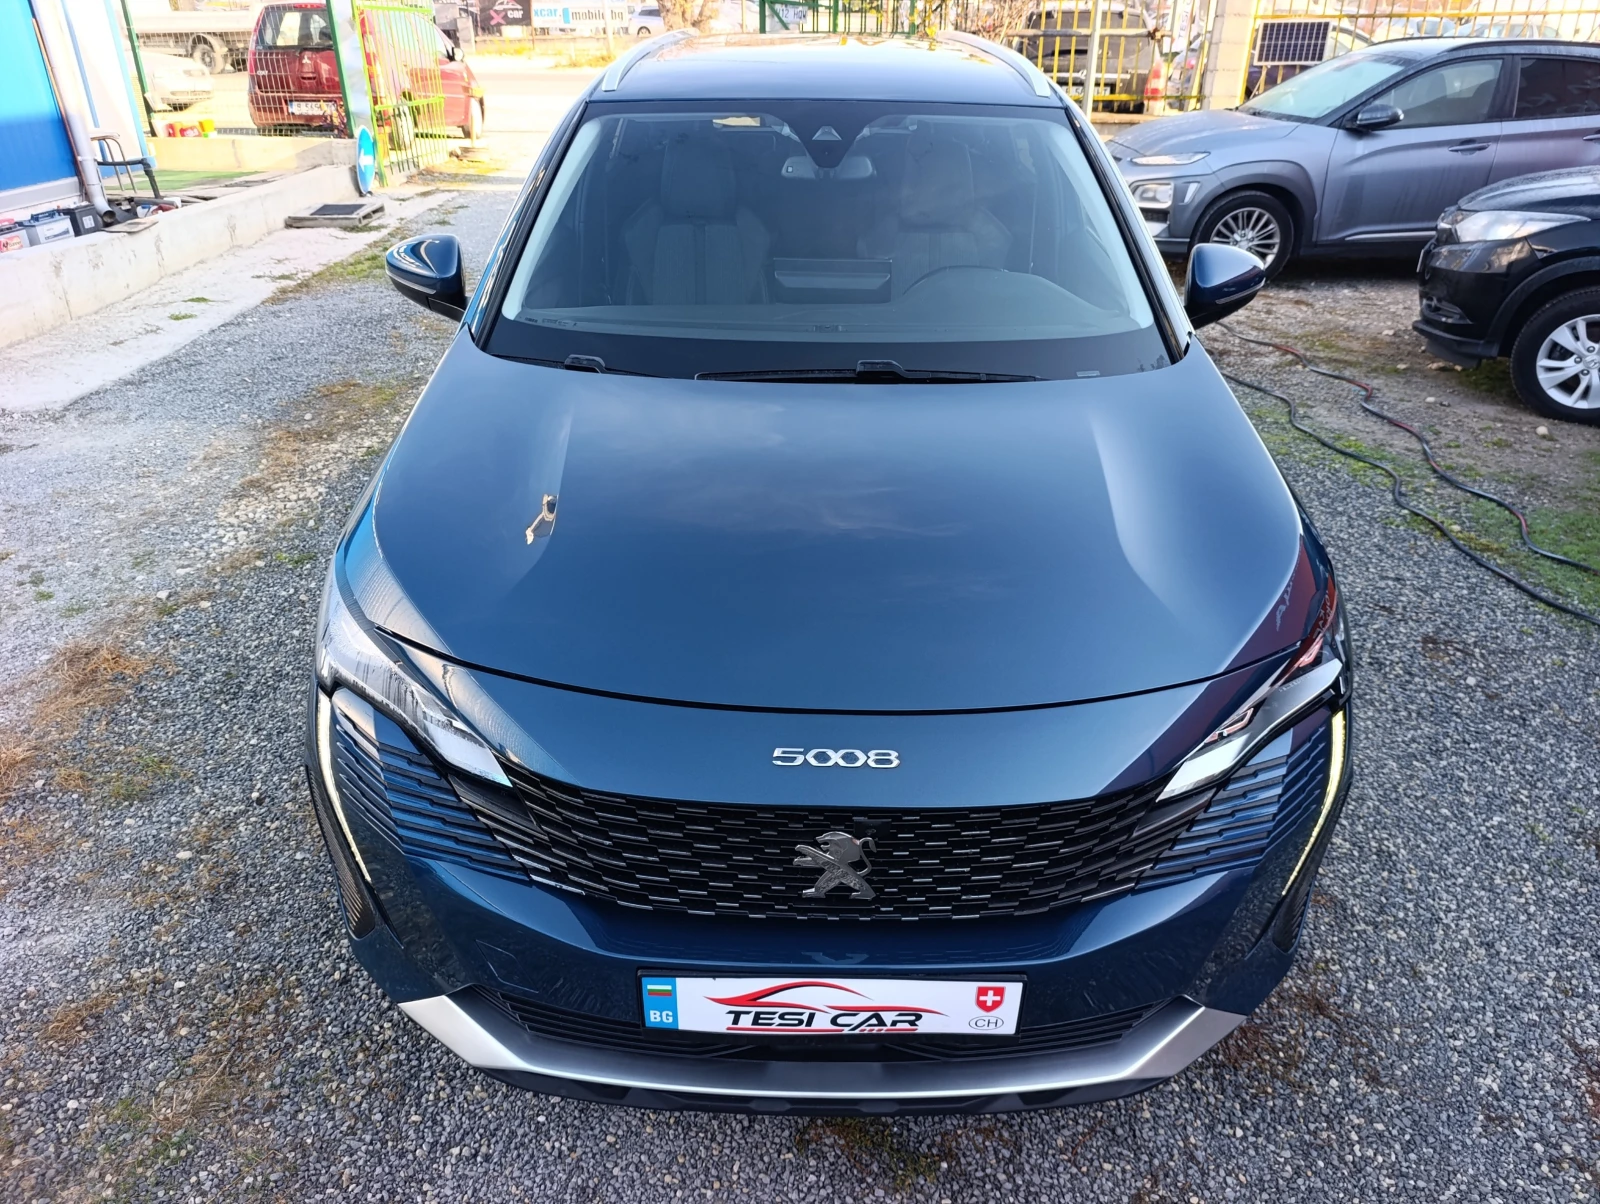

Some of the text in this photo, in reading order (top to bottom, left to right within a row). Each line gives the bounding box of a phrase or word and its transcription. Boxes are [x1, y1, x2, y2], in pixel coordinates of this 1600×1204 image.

[507, 10, 524, 18] car
[772, 747, 901, 769] 5008
[649, 1010, 673, 1023] BG
[725, 1010, 923, 1032] TESI CAR
[974, 1018, 998, 1029] CH
